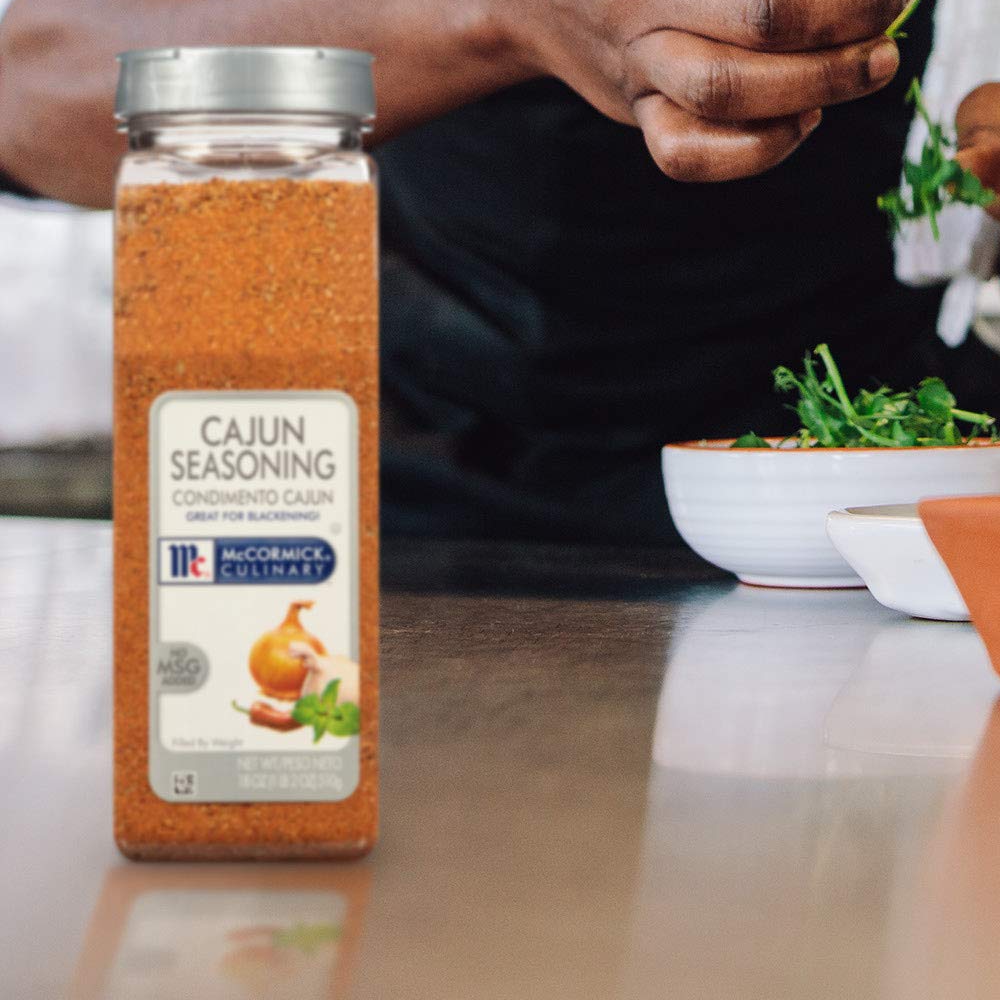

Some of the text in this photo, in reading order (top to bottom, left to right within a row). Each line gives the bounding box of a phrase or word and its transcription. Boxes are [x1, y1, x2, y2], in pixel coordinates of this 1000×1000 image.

[200, 415, 305, 447] CAJUN
[171, 449, 336, 481] SEASONING
[172, 489, 334, 506] CONDIMENTO CAJUN
[186, 511, 320, 522] GREAT FOR BLACKENING!
[220, 564, 325, 577] CULINARY
[156, 658, 201, 675] MSG
